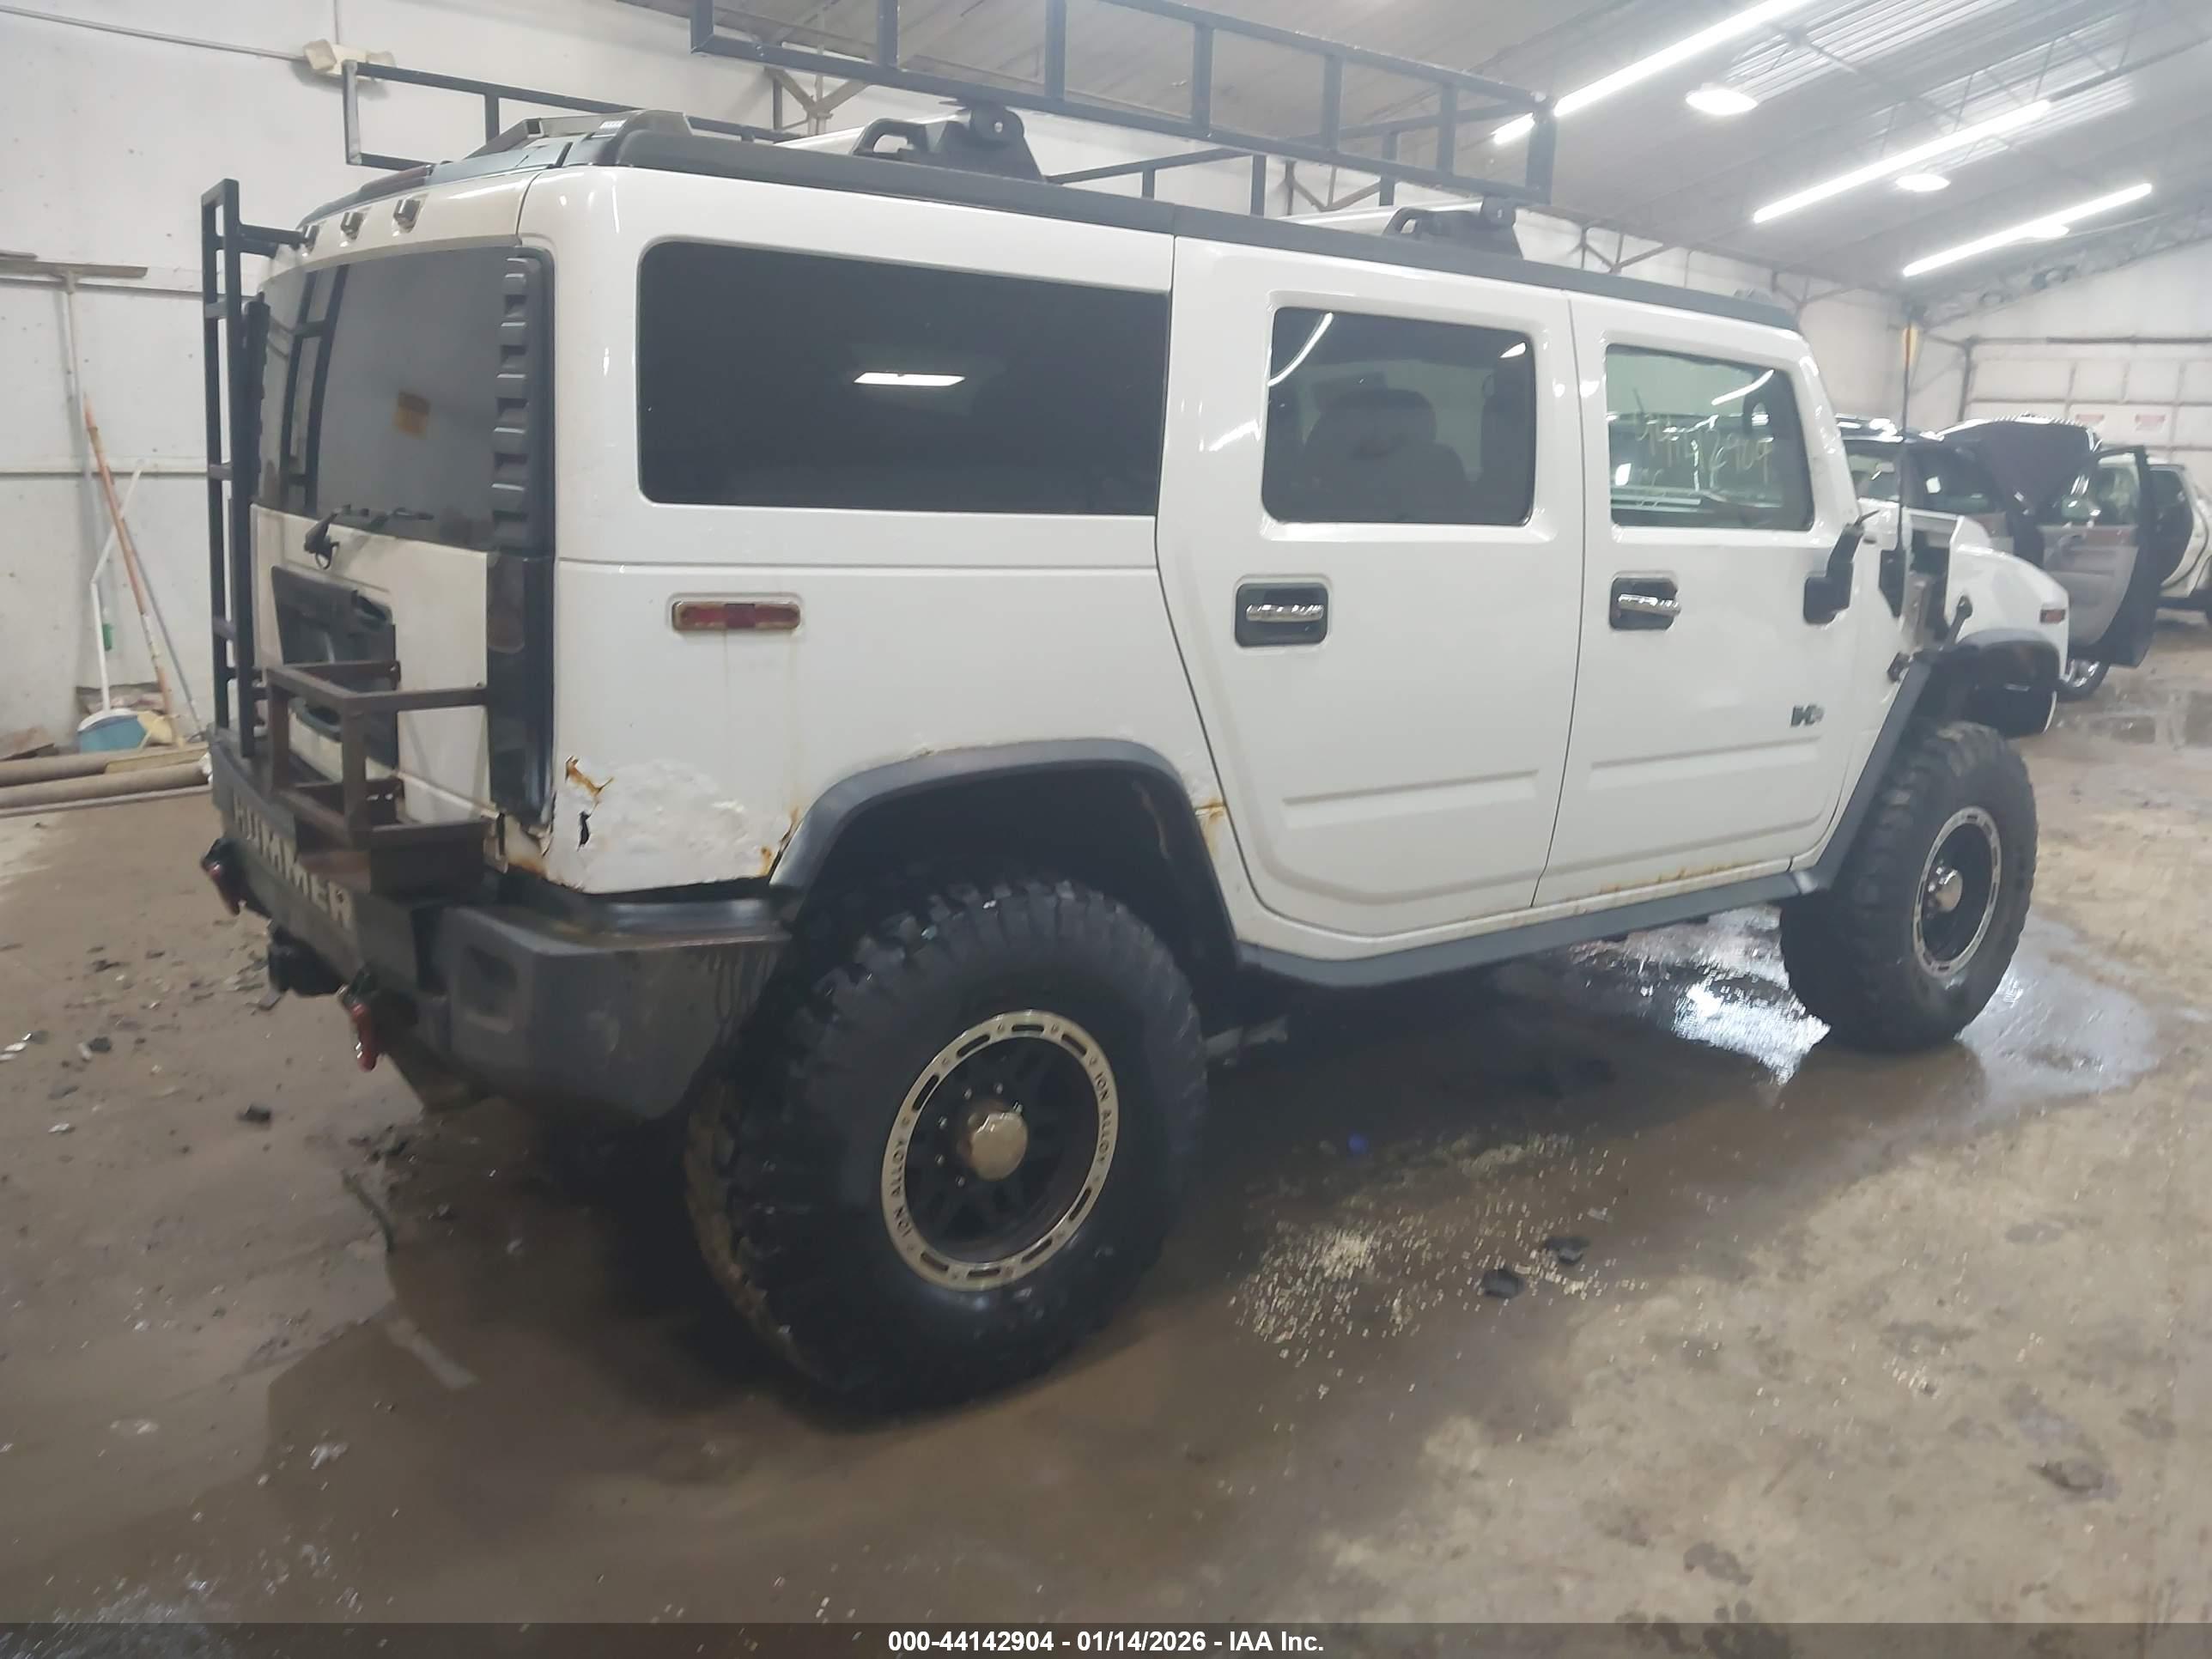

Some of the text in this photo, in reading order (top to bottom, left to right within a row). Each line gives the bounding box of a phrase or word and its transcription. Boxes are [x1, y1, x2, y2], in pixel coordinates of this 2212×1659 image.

[233, 795, 353, 930] HUMMER
[1095, 1071, 1113, 1163] ION ALLOY
[889, 1139, 913, 1232] ION ALLOY
